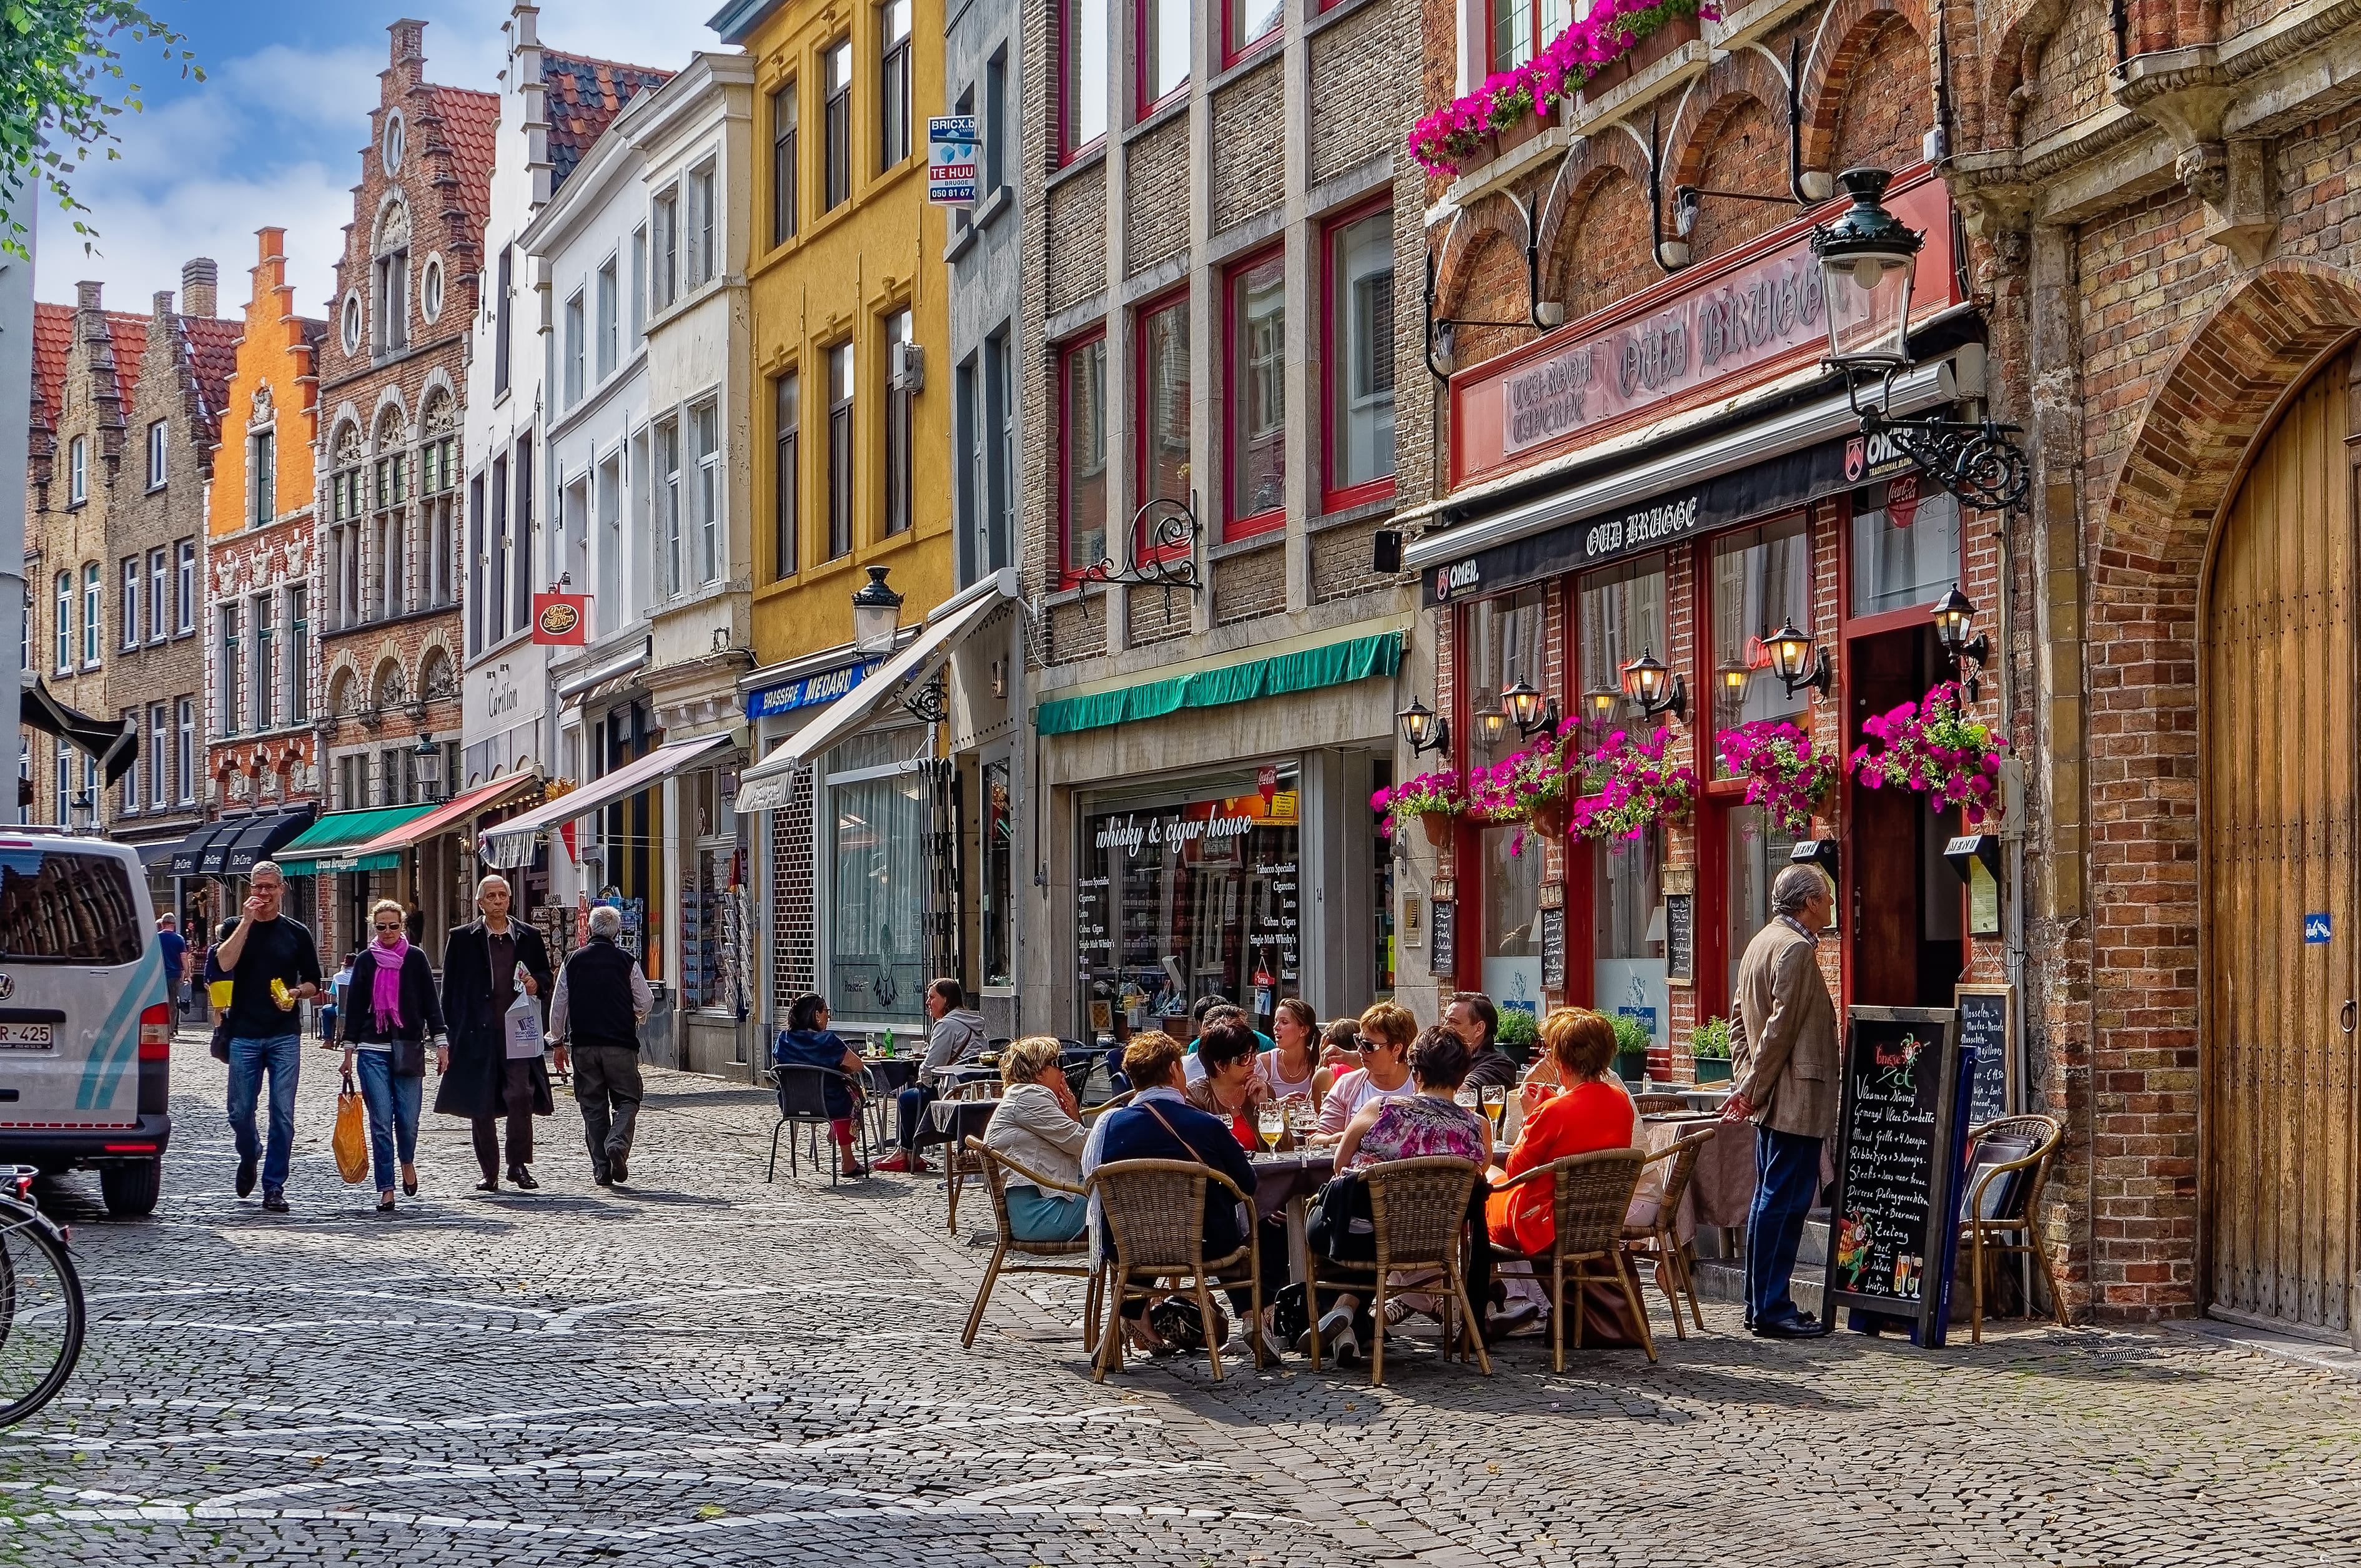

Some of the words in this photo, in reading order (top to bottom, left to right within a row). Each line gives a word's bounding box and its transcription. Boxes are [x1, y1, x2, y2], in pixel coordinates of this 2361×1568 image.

[931, 119, 974, 130] BRICX.b
[931, 168, 946, 179] TE
[949, 167, 974, 178] HUU
[932, 189, 946, 198] 050
[948, 189, 958, 197] 81
[960, 188, 969, 197] 67
[1620, 320, 1686, 398] OUD
[1869, 461, 1898, 477] TRADITIONAL
[1586, 521, 1622, 556] OUD
[1625, 496, 1698, 550] BRUGGE
[763, 684, 800, 709] BRASSERIE
[804, 668, 853, 701] MEDARD
[489, 681, 517, 717] Carillon
[1096, 814, 1144, 858] whisky
[1148, 817, 1162, 844] &
[1166, 814, 1205, 854] cigar
[1207, 804, 1254, 837] house
[1948, 839, 1977, 851] MENU
[1275, 862, 1295, 875] Specialist
[1093, 876, 1109, 888] Specialist
[1273, 881, 1295, 893] Cigarettes
[1079, 894, 1096, 904] Cigarettes
[1316, 887, 1322, 902] 14
[1283, 899, 1296, 908] Lotto
[1264, 917, 1279, 926] Cuban
[1281, 916, 1296, 929] Cigars
[1079, 925, 1091, 933] Cuban
[1092, 924, 1104, 935] Cigars
[1079, 940, 1089, 951] Single
[1090, 939, 1098, 948] Malt
[1099, 939, 1115, 950] Whisky's
[1250, 935, 1264, 947] Single
[1264, 934, 1275, 944] Malt
[1275, 934, 1296, 946] Whisky's
[1079, 955, 1089, 964] Wine
[1284, 952, 1296, 962] Wine
[1079, 971, 1090, 979] Rhum
[1282, 969, 1296, 979] Rhum
[1962, 1002, 1989, 1020] Mosselen
[1876, 1065, 1917, 1088] Zot
[1857, 1073, 1888, 1099] Vlaamse
[1854, 1103, 1883, 1124] Gemengd
[1903, 1108, 1934, 1123] Brochette
[1853, 1127, 1873, 1141] Mixed
[1874, 1130, 1893, 1150] Grille
[1849, 1164, 1876, 1181] Steaks
[1847, 1185, 1873, 1198] Diverse
[1874, 1221, 1909, 1245] Zeetong
